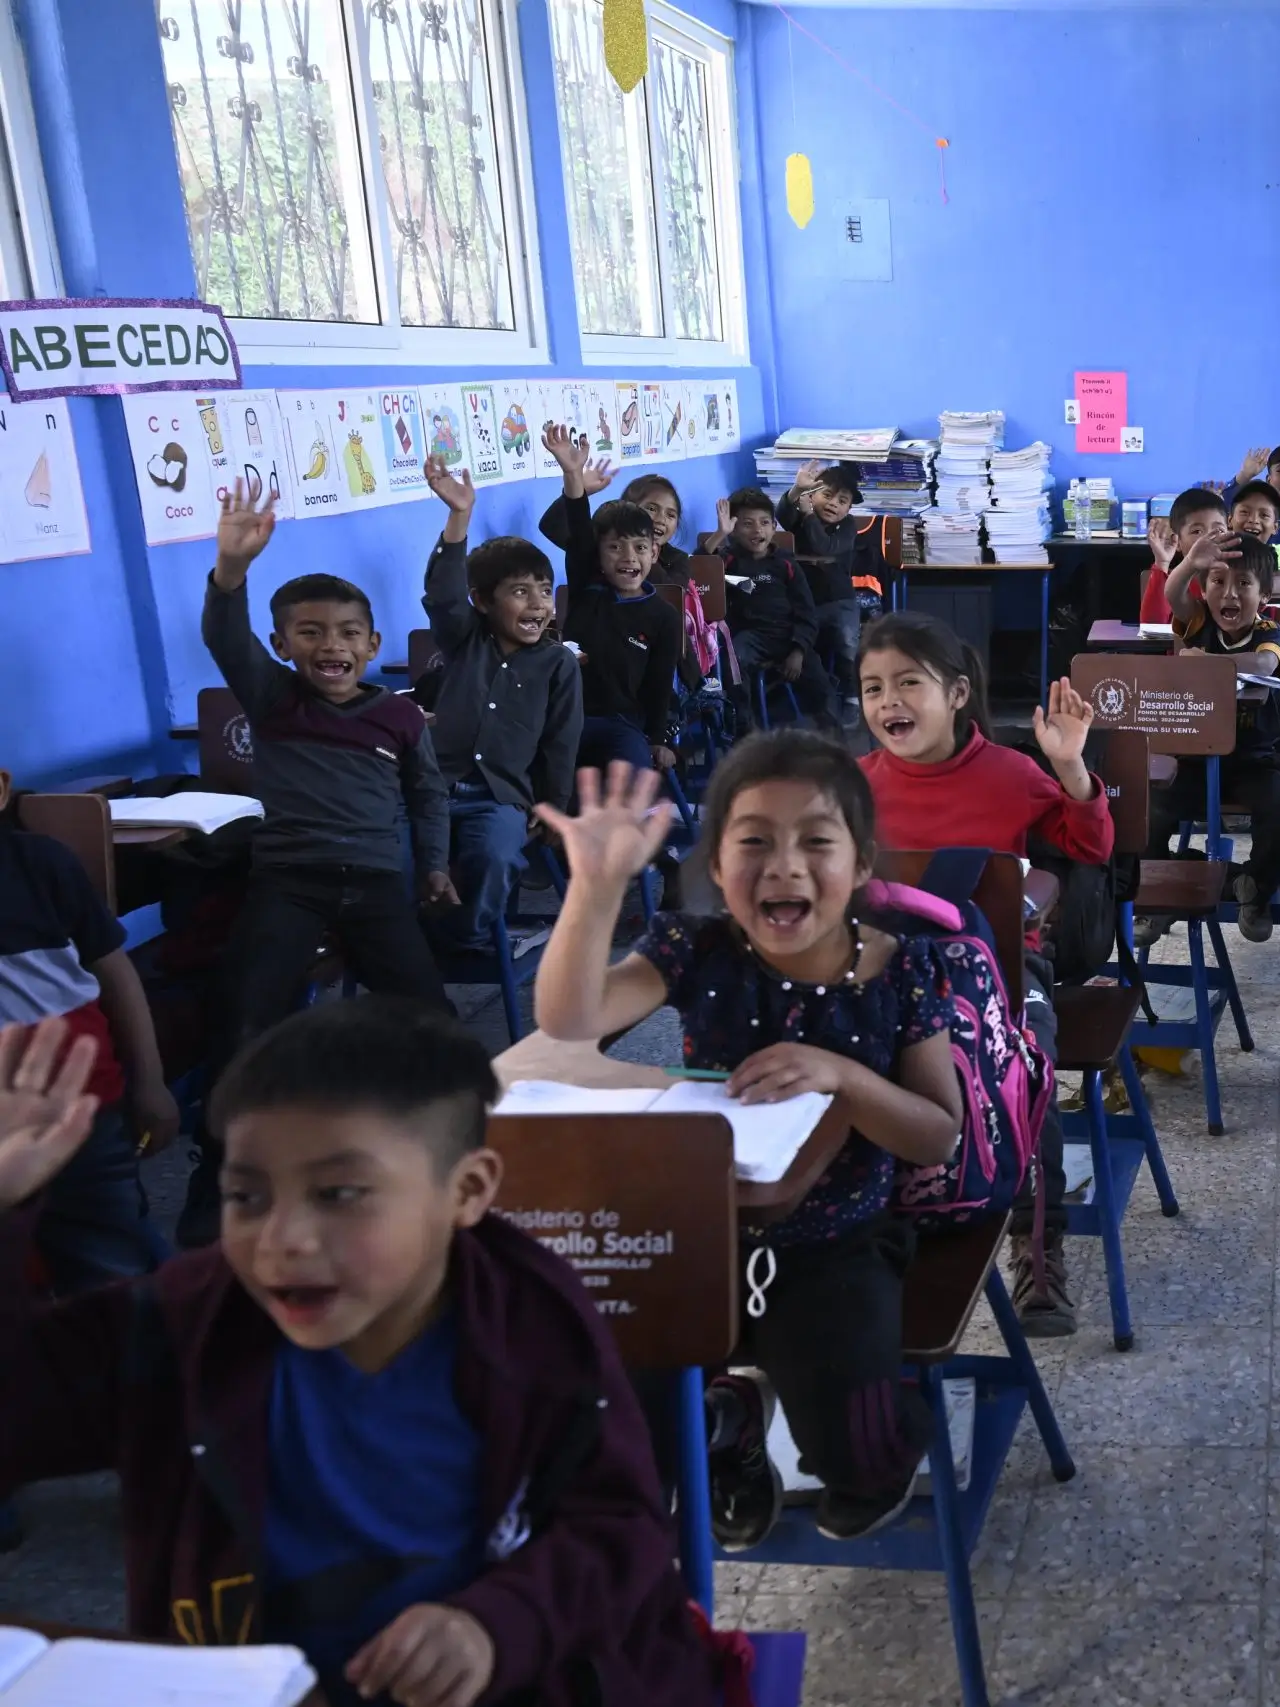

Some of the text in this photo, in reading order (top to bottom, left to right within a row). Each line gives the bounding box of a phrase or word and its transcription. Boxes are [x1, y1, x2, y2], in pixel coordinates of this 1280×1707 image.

[338, 400, 346, 421] J
[1087, 411, 1115, 419] Rincón
[45, 413, 57, 430] n
[148, 416, 160, 433] C
[1096, 423, 1106, 431] de
[1087, 435, 1115, 443] lectura
[478, 461, 497, 472] vaca
[304, 494, 328, 506] banano
[165, 506, 194, 519] Coco
[1140, 690, 1194, 700] Ministerio de
[1140, 700, 1214, 711] Desarrollo Social
[590, 1207, 620, 1229] de
[603, 1229, 674, 1255] Social
